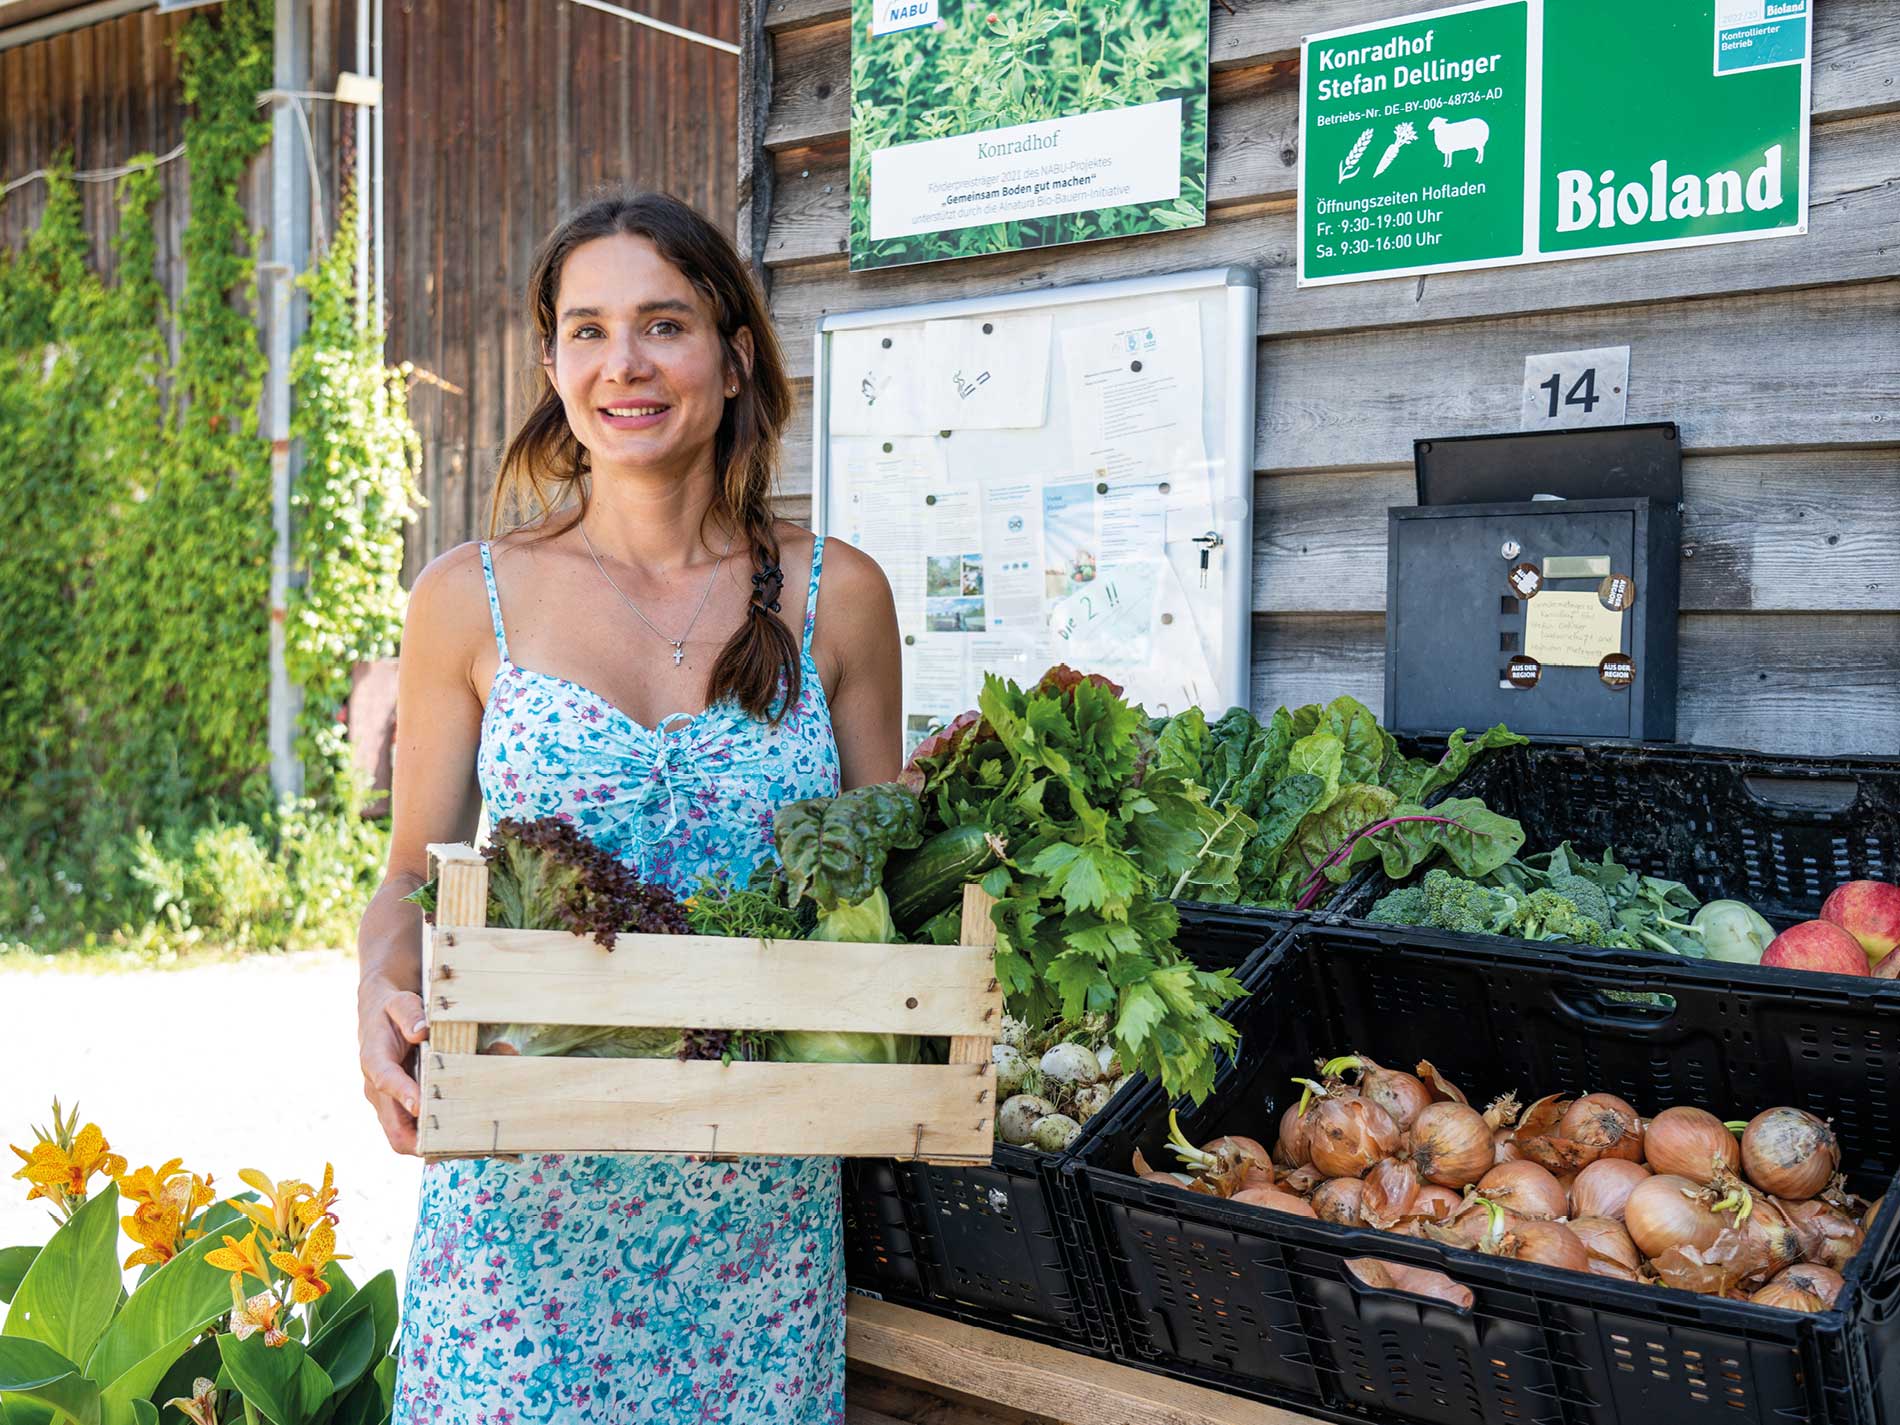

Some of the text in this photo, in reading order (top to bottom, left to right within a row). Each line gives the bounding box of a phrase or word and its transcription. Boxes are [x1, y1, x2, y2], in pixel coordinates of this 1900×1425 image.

[890, 2, 928, 21] NABU
[1767, 2, 1804, 16] Bioland
[1721, 25, 1781, 41] Kontrollierter
[1721, 39, 1752, 51] Betrieb
[1319, 30, 1434, 72] Konradhof
[1318, 54, 1501, 101] Stefan Dellinger
[1317, 87, 1503, 126] Betriebs-Nr. DE-BY-006-48736-AD
[977, 129, 1061, 160] Konradhof
[1001, 171, 1022, 182] 2021
[1023, 168, 1039, 180] des
[1041, 156, 1112, 176] NABU-Projektes
[941, 174, 1096, 207] „Gemeinsam Boden gut machen“
[1316, 181, 1487, 215] Öffnungszeiten Hofladen
[1556, 144, 1783, 232] Bioland
[958, 205, 983, 219] durch
[983, 202, 998, 215] die
[999, 197, 1036, 213] Alnatura
[1317, 209, 1444, 237] Fr. 9:30-19:00 Uhr
[1316, 232, 1443, 259] Sa. 9:30-16:00 Uhr
[1540, 368, 1599, 418] 14
[1080, 596, 1099, 621] 2
[1511, 664, 1537, 672] AUS DER
[1512, 671, 1536, 679] REGION
[1603, 663, 1631, 672] AUS DER
[1604, 671, 1630, 679] REGION
